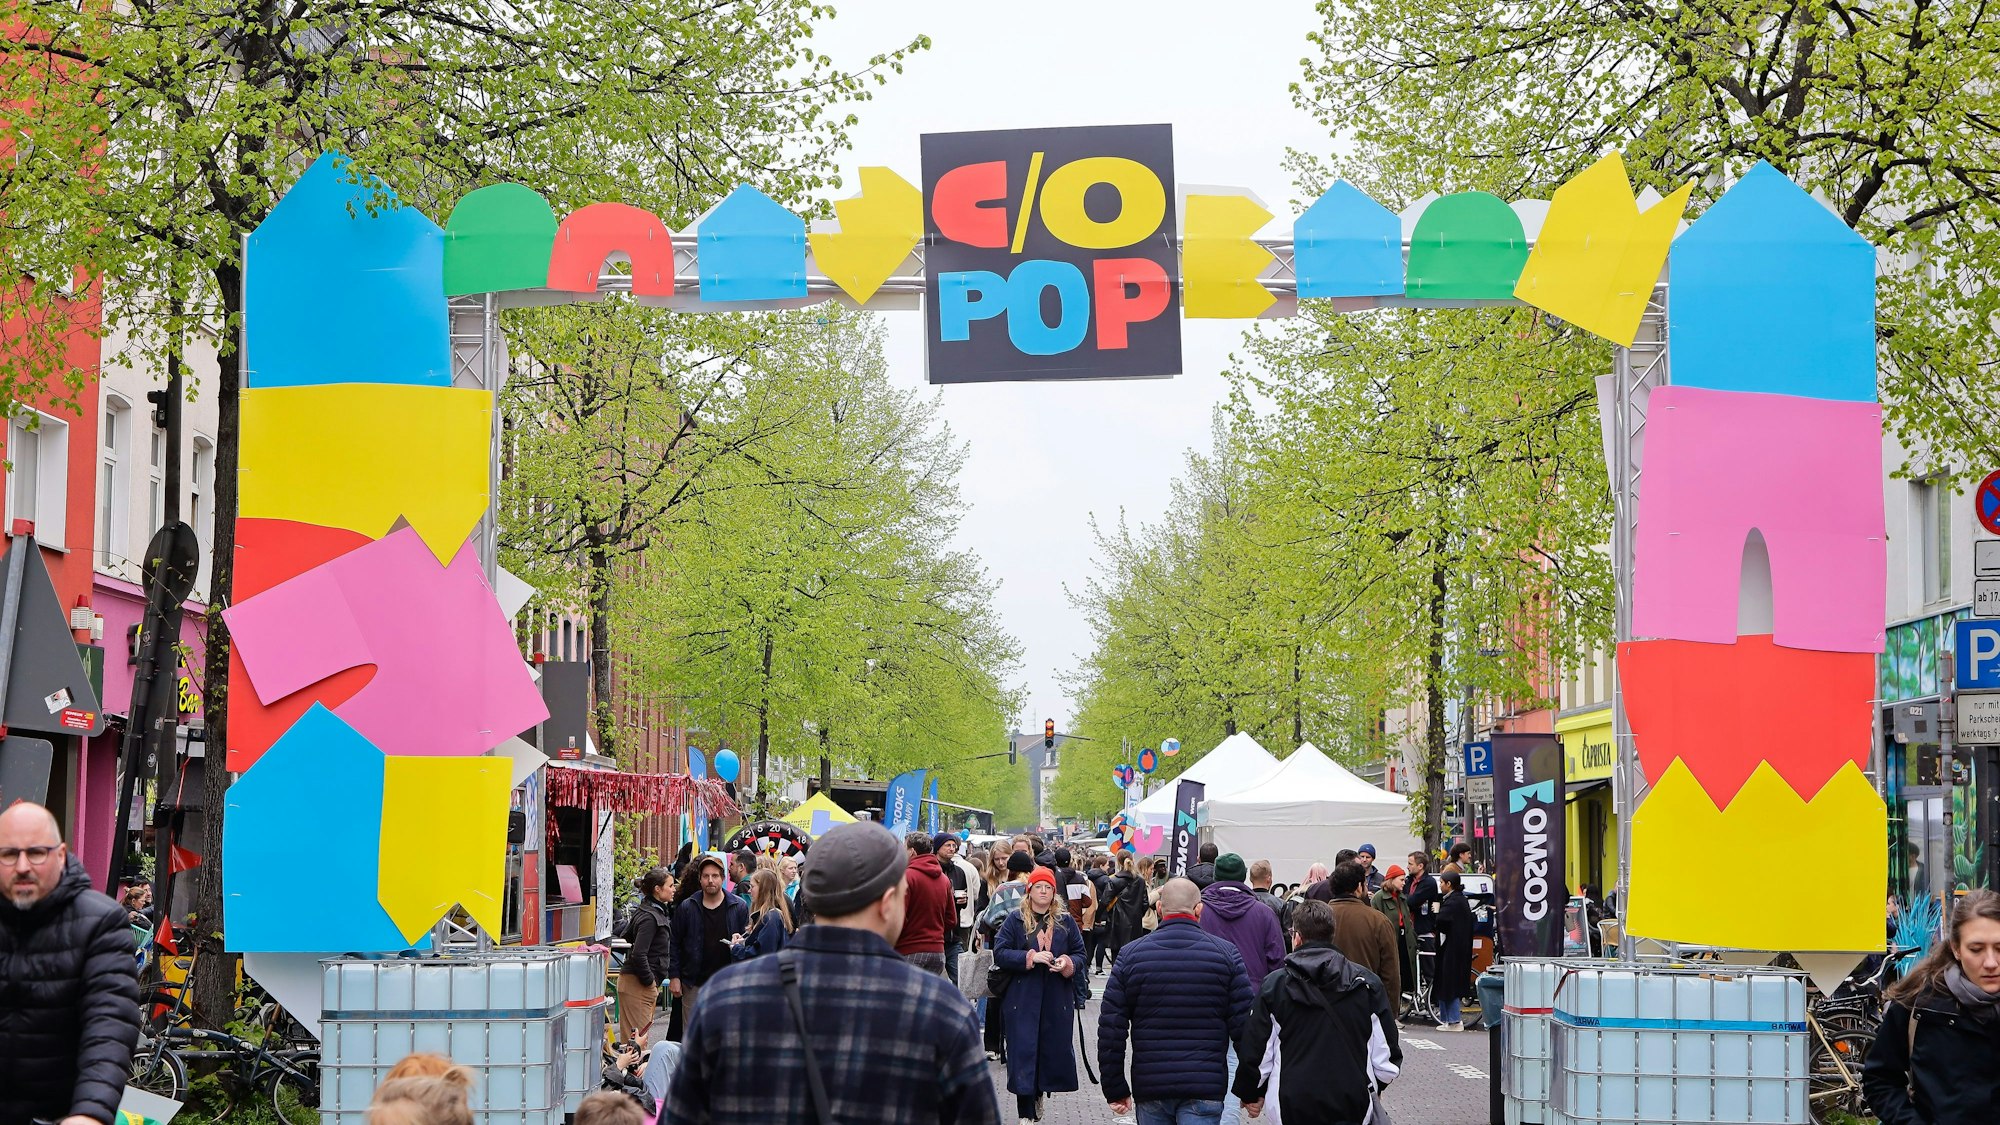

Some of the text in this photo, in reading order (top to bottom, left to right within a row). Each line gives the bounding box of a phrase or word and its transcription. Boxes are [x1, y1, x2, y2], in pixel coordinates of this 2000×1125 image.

[931, 151, 1167, 254] C/O
[938, 257, 1172, 355] POP
[1978, 592, 1987, 602] ab
[1970, 628, 2000, 681] P
[1909, 706, 1923, 716] 021
[1973, 700, 2000, 710] nur mit
[1961, 729, 1991, 740] werktags
[1470, 746, 1486, 772] P
[733, 840, 739, 848] 9
[740, 830, 751, 838] 12
[757, 825, 763, 833] 5
[770, 824, 780, 832] 20
[787, 827, 792, 835] 1
[797, 835, 806, 844] 18
[1772, 1023, 1801, 1031] BARWA
